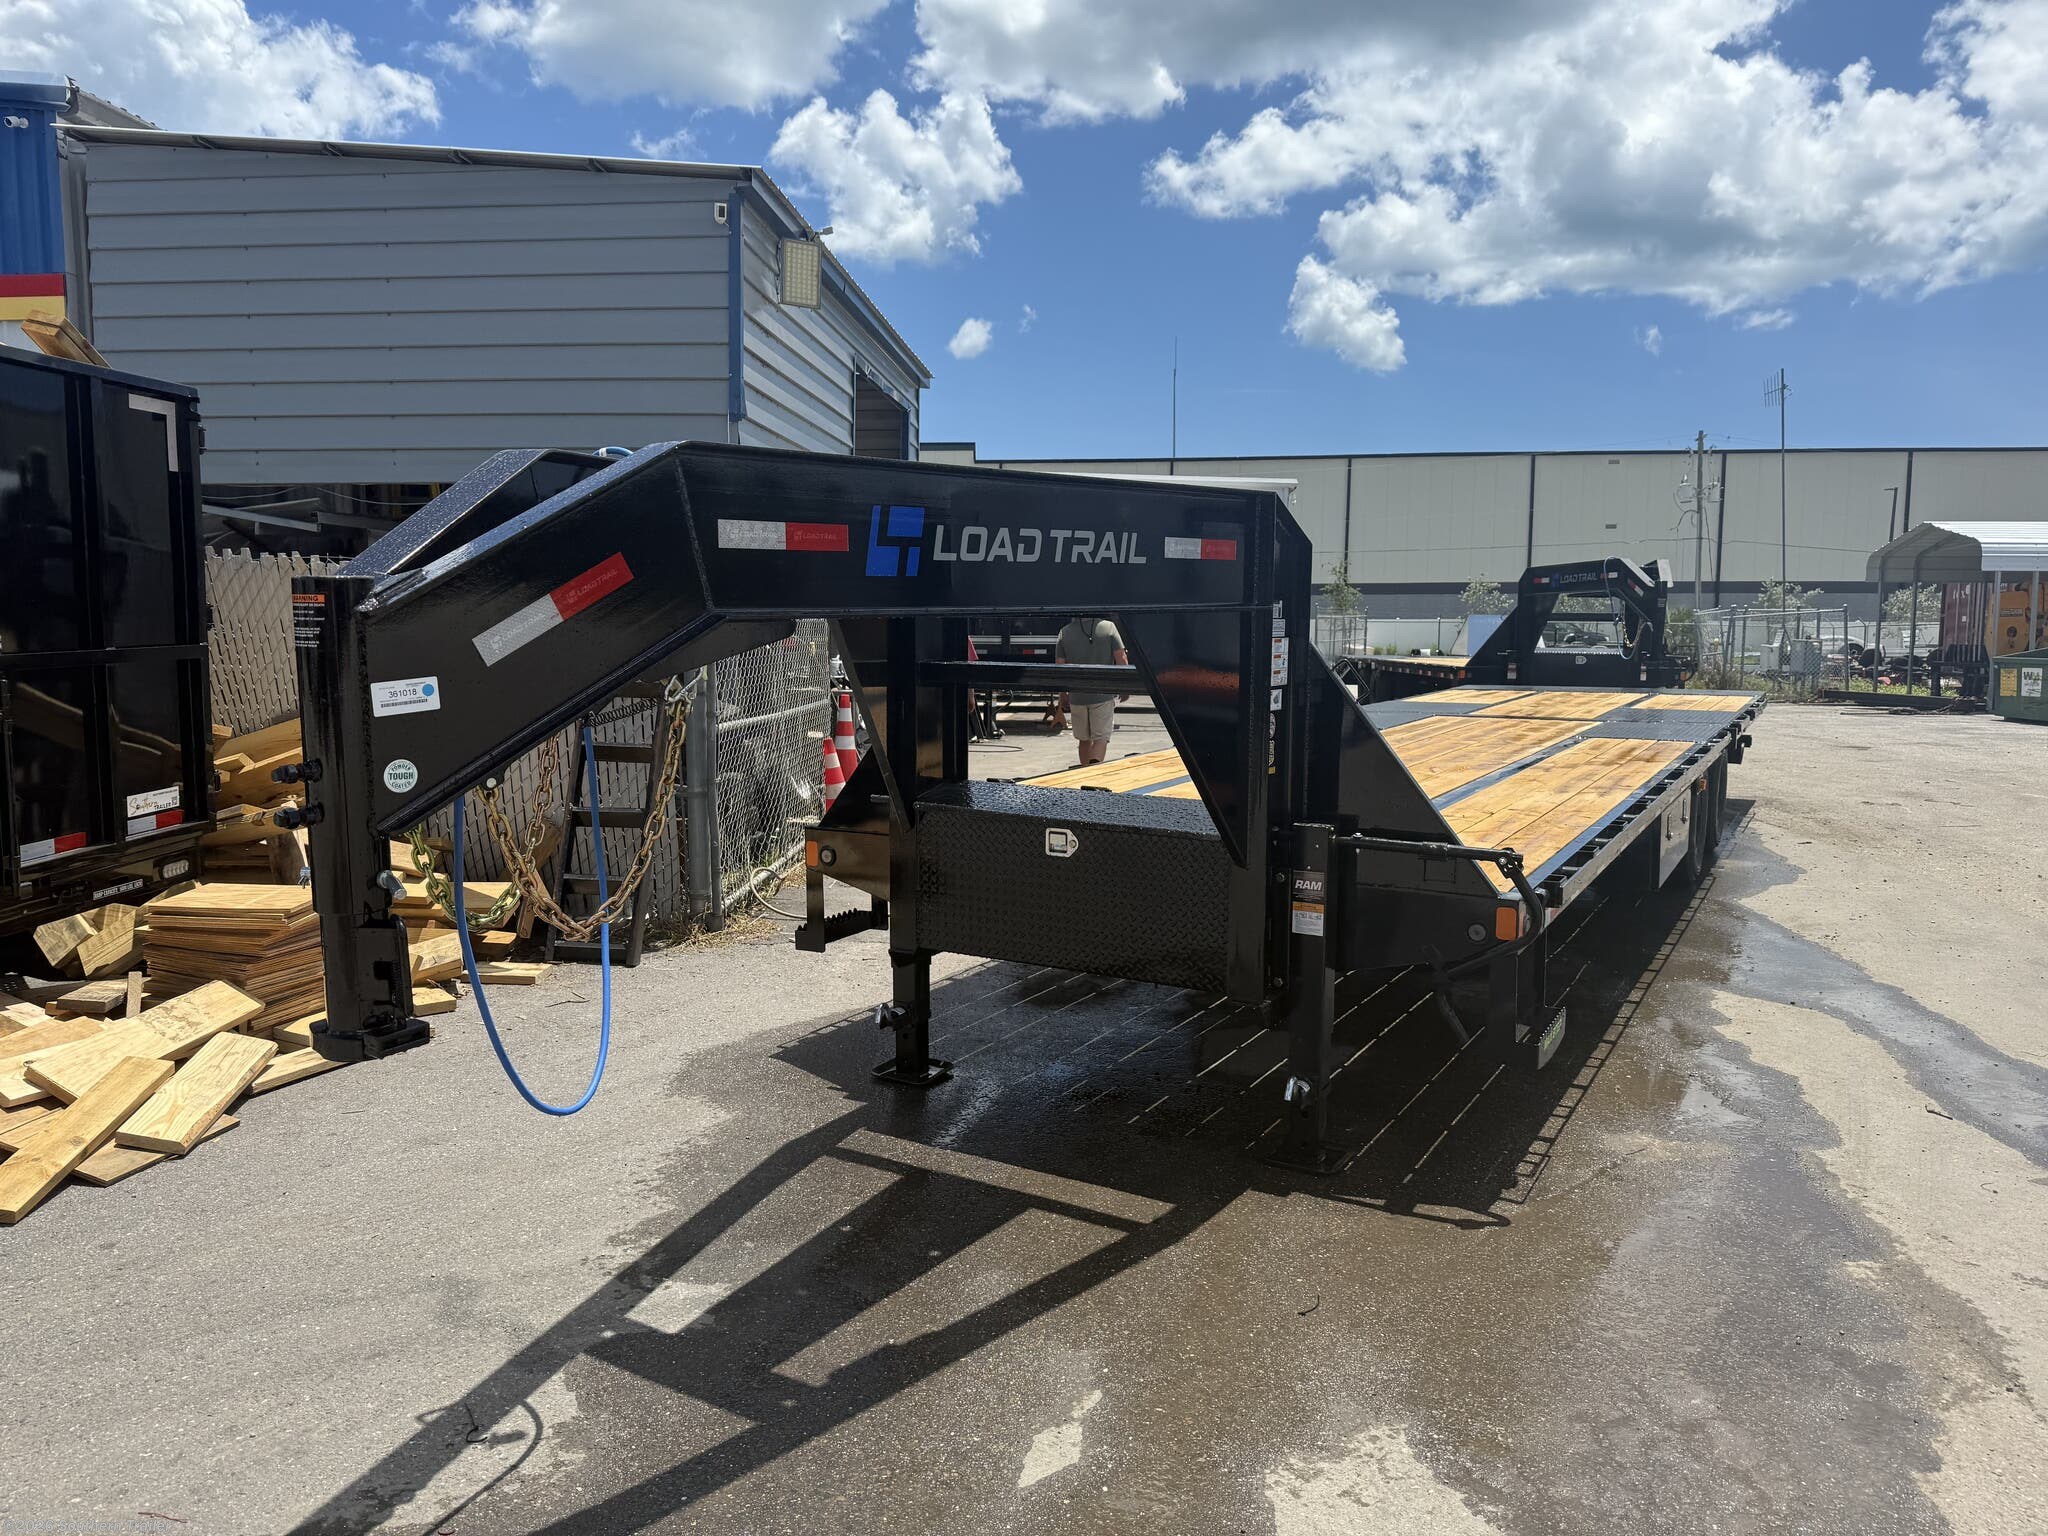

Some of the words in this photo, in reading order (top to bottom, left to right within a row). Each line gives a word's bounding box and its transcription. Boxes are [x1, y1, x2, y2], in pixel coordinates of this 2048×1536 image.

[933, 525, 1042, 562] LOAD
[1050, 529, 1147, 564] TRAIL
[388, 688, 417, 699] 361018
[388, 772, 414, 781] TOUGH
[1295, 879, 1322, 891] RAM
